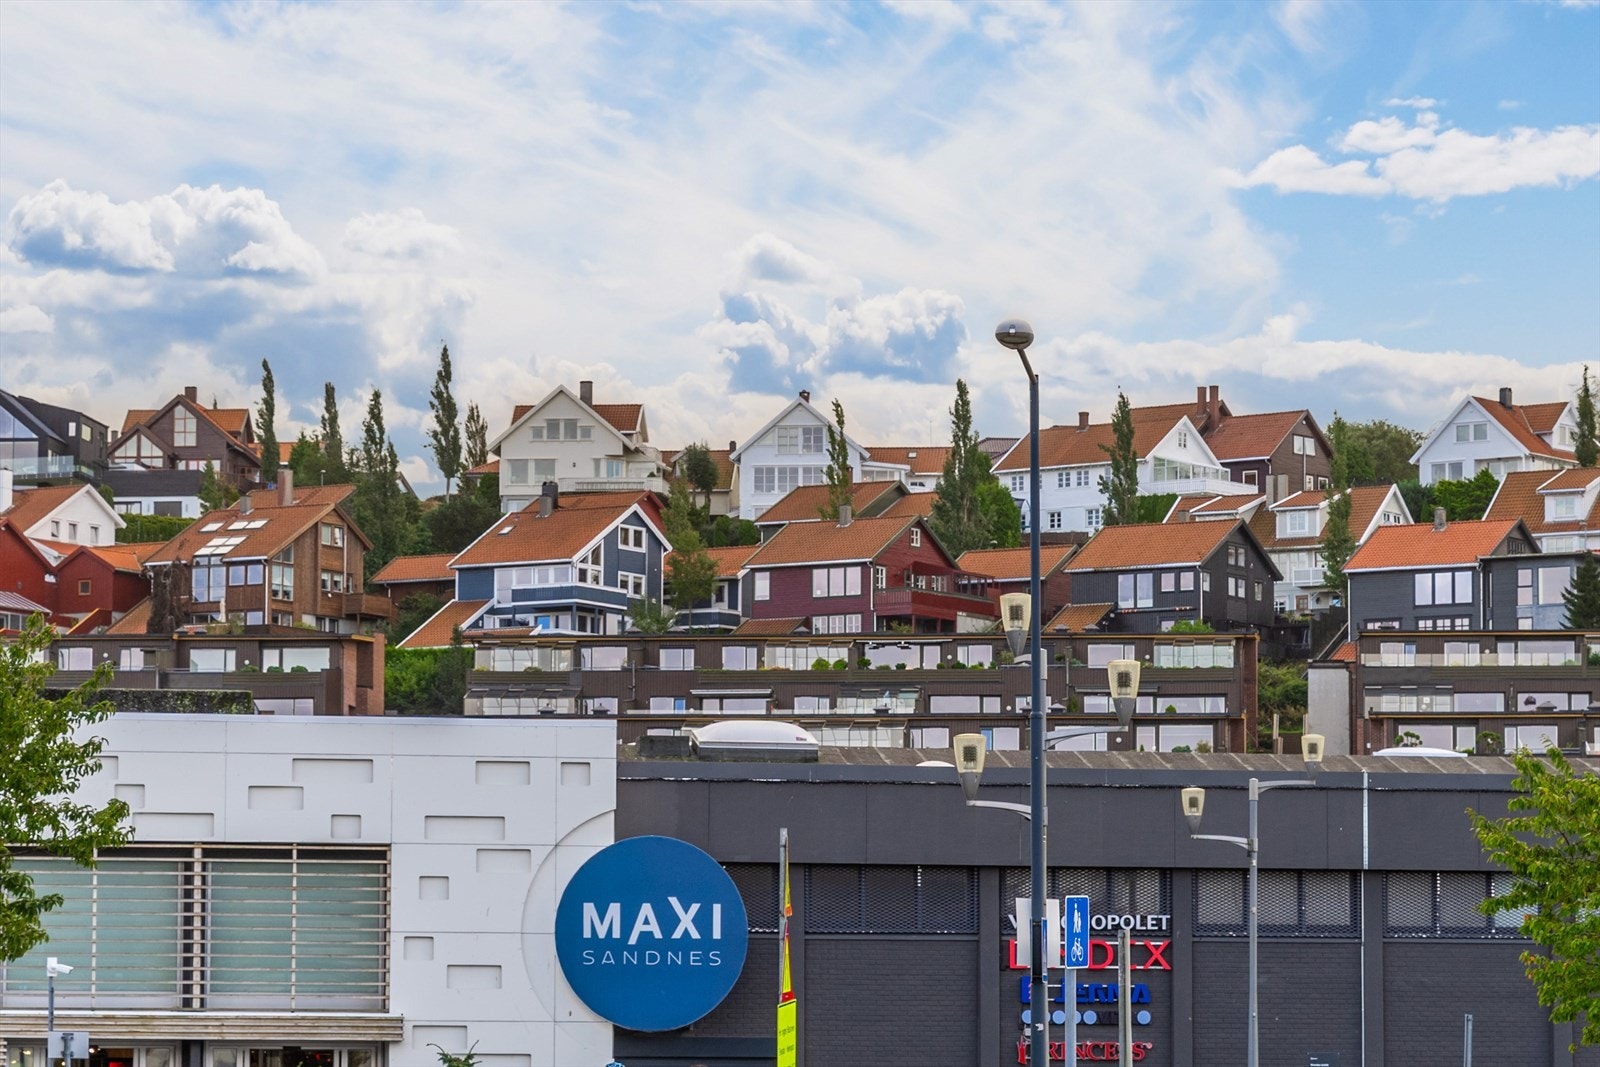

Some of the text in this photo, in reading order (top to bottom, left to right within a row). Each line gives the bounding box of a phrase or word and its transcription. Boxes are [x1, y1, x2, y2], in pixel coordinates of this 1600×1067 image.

[583, 896, 722, 945] MAXI
[1008, 914, 1171, 931] VOPOLET
[582, 950, 722, 966] SANDNES
[1009, 939, 1172, 970] LDX
